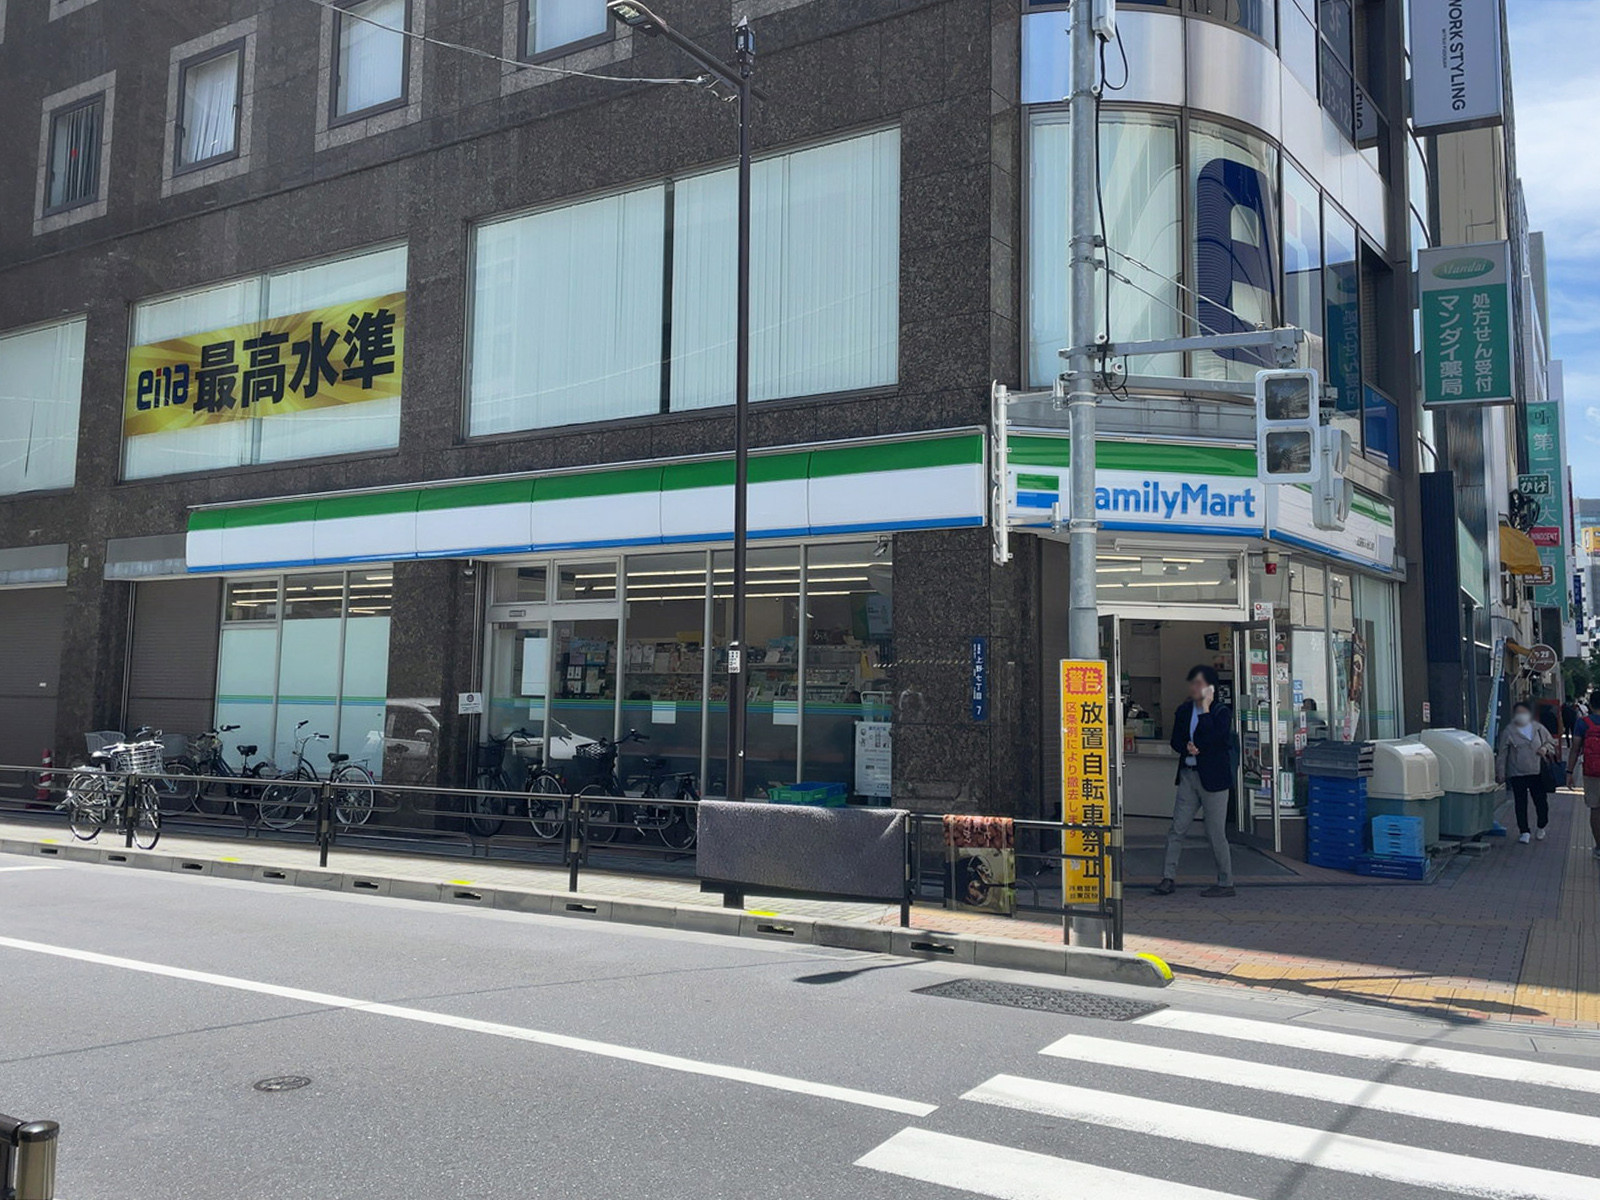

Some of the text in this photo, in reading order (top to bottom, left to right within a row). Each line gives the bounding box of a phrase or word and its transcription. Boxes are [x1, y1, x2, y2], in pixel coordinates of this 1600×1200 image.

[1450, 42, 1466, 111] STYLING
[193, 308, 396, 414] 最高水準
[1438, 295, 1463, 396] マンダイ薬局
[1472, 294, 1493, 393] 処方せん受付
[1095, 480, 1256, 519] amilyMart
[1520, 480, 1547, 493] ひげ
[1080, 701, 1105, 878] 放置自転車禁止
